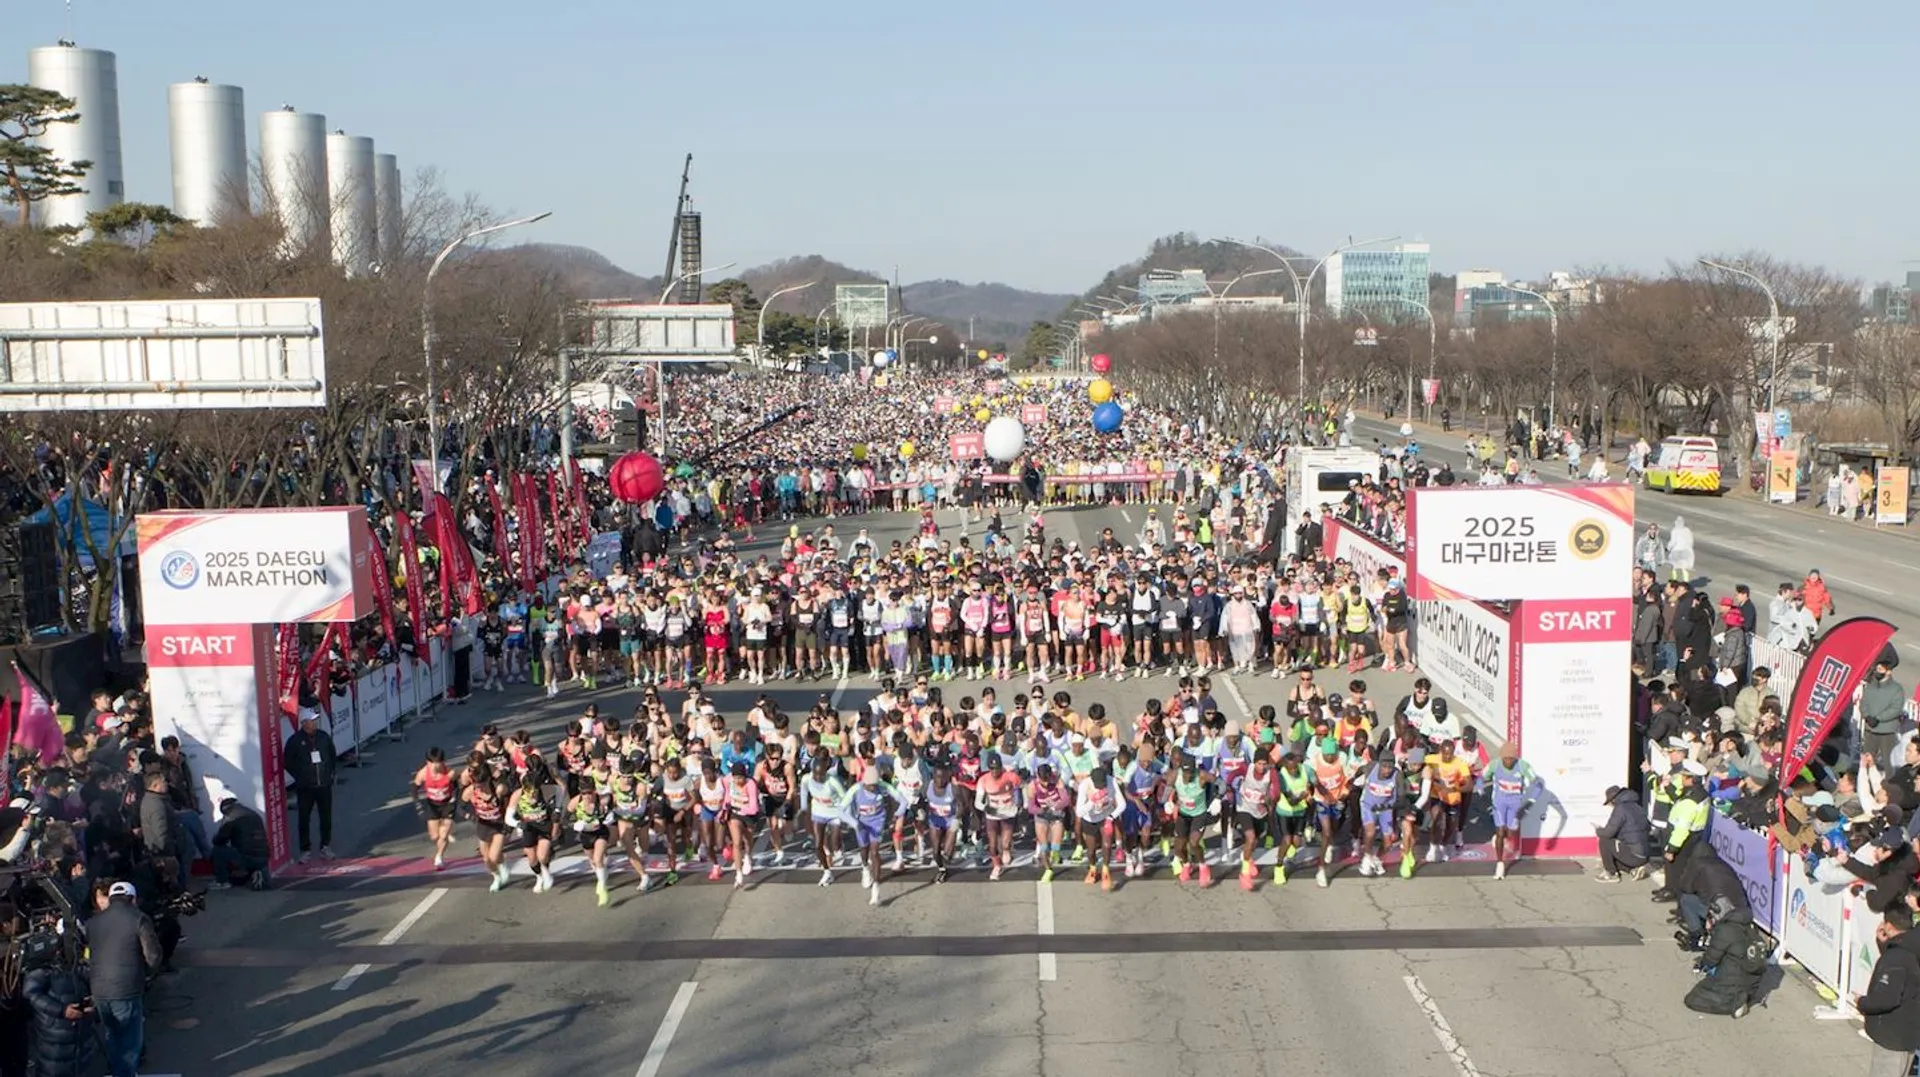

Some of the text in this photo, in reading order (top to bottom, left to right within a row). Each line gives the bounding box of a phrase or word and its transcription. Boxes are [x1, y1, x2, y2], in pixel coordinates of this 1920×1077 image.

[1882, 490, 1891, 507] 3
[1464, 516, 1535, 538] 2025
[205, 551, 326, 568] 2025 DAEGU
[1441, 540, 1557, 564] 대구마라톤
[207, 570, 328, 587] MARATHON
[1538, 610, 1616, 632] START
[161, 635, 236, 657] START
[1419, 600, 1472, 659] MARATHON
[1474, 623, 1500, 679] 2025
[1714, 828, 1745, 867] ORLD
